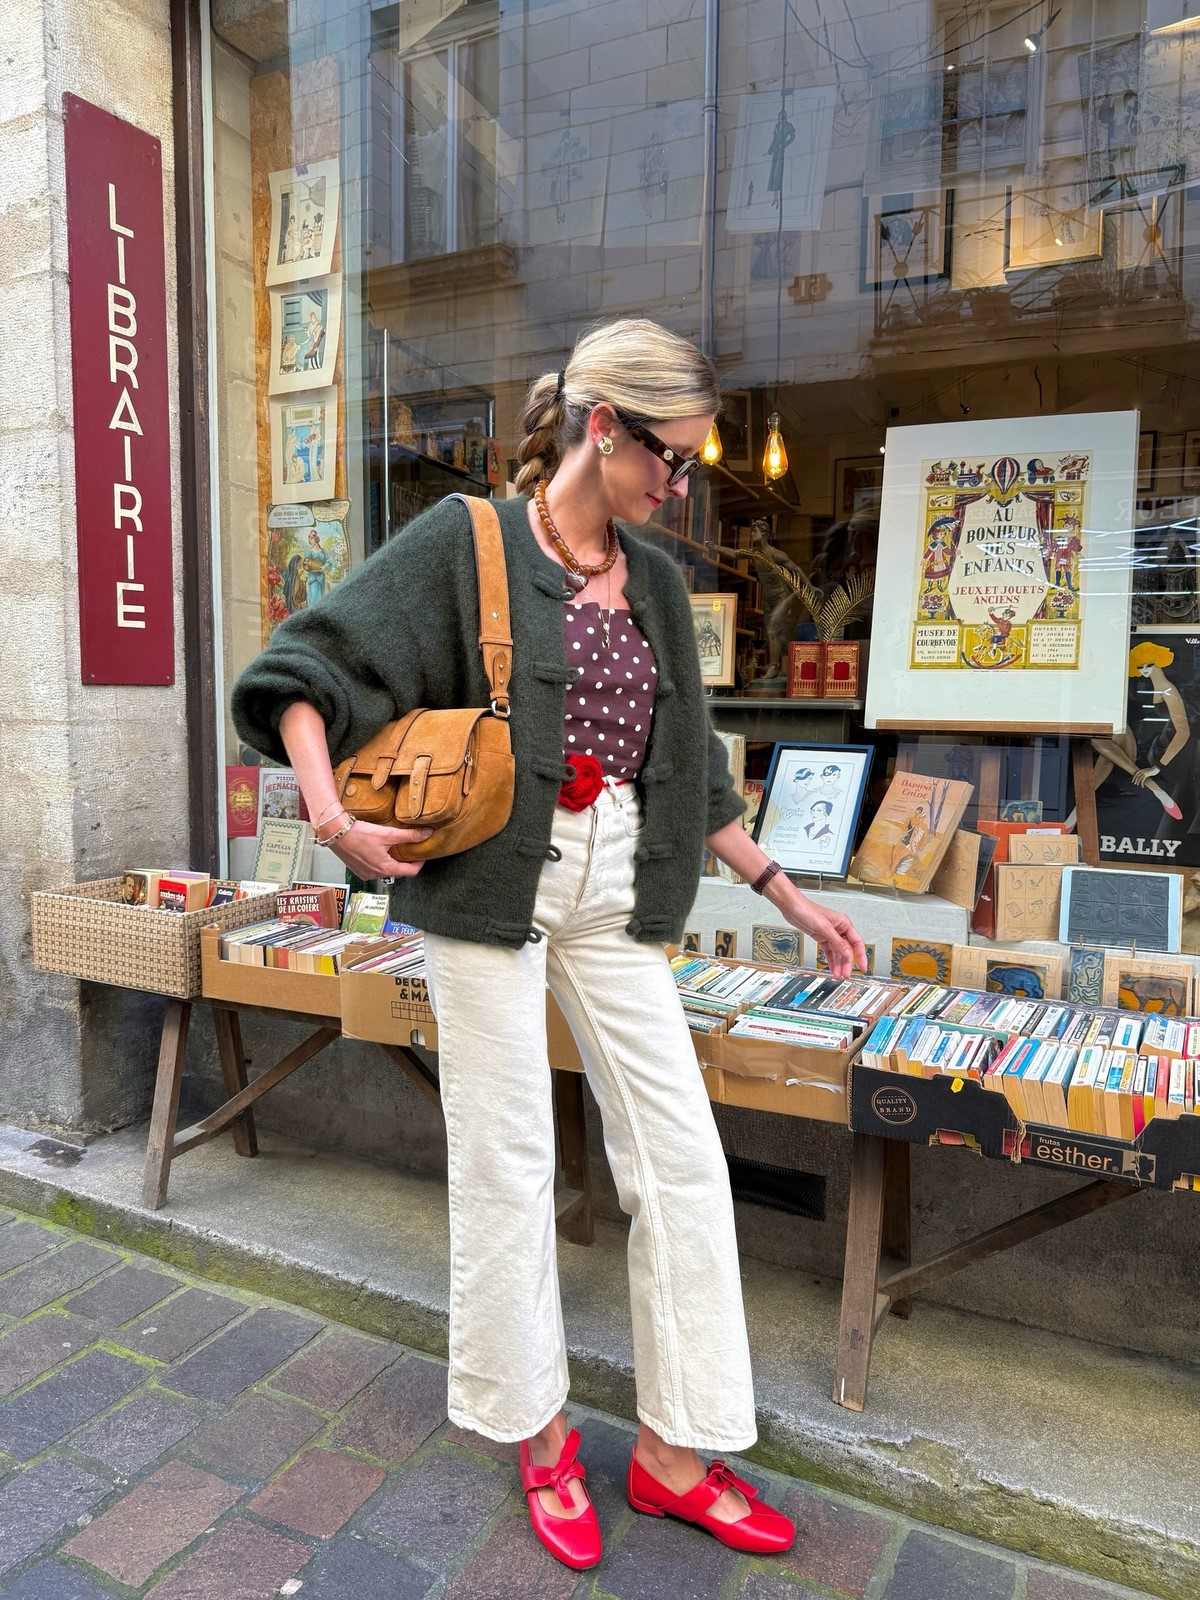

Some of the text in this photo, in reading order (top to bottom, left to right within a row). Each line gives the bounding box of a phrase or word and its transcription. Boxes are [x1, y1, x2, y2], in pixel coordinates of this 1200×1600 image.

[107, 182, 146, 630] LIBRAIRIE
[992, 508, 1014, 523] AU
[965, 525, 1038, 543] BONHEUR
[984, 542, 1016, 556] DES
[963, 559, 1035, 577] ENFANTS
[953, 585, 1045, 596] JEUX ET JOUETS
[973, 595, 1020, 605] ANCIENS
[946, 628, 958, 637] DE
[916, 638, 958, 648] COURBEVOIE
[1100, 835, 1182, 857] BALLY
[276, 895, 318, 906] LES RAISINS
[278, 905, 287, 914] DE
[288, 904, 297, 913] LA
[400, 989, 408, 1000] &
[876, 1097, 908, 1106] QUALITY
[879, 1105, 912, 1114] BRAND
[1039, 1136, 1061, 1147] frutas
[1036, 1144, 1112, 1171] esther
